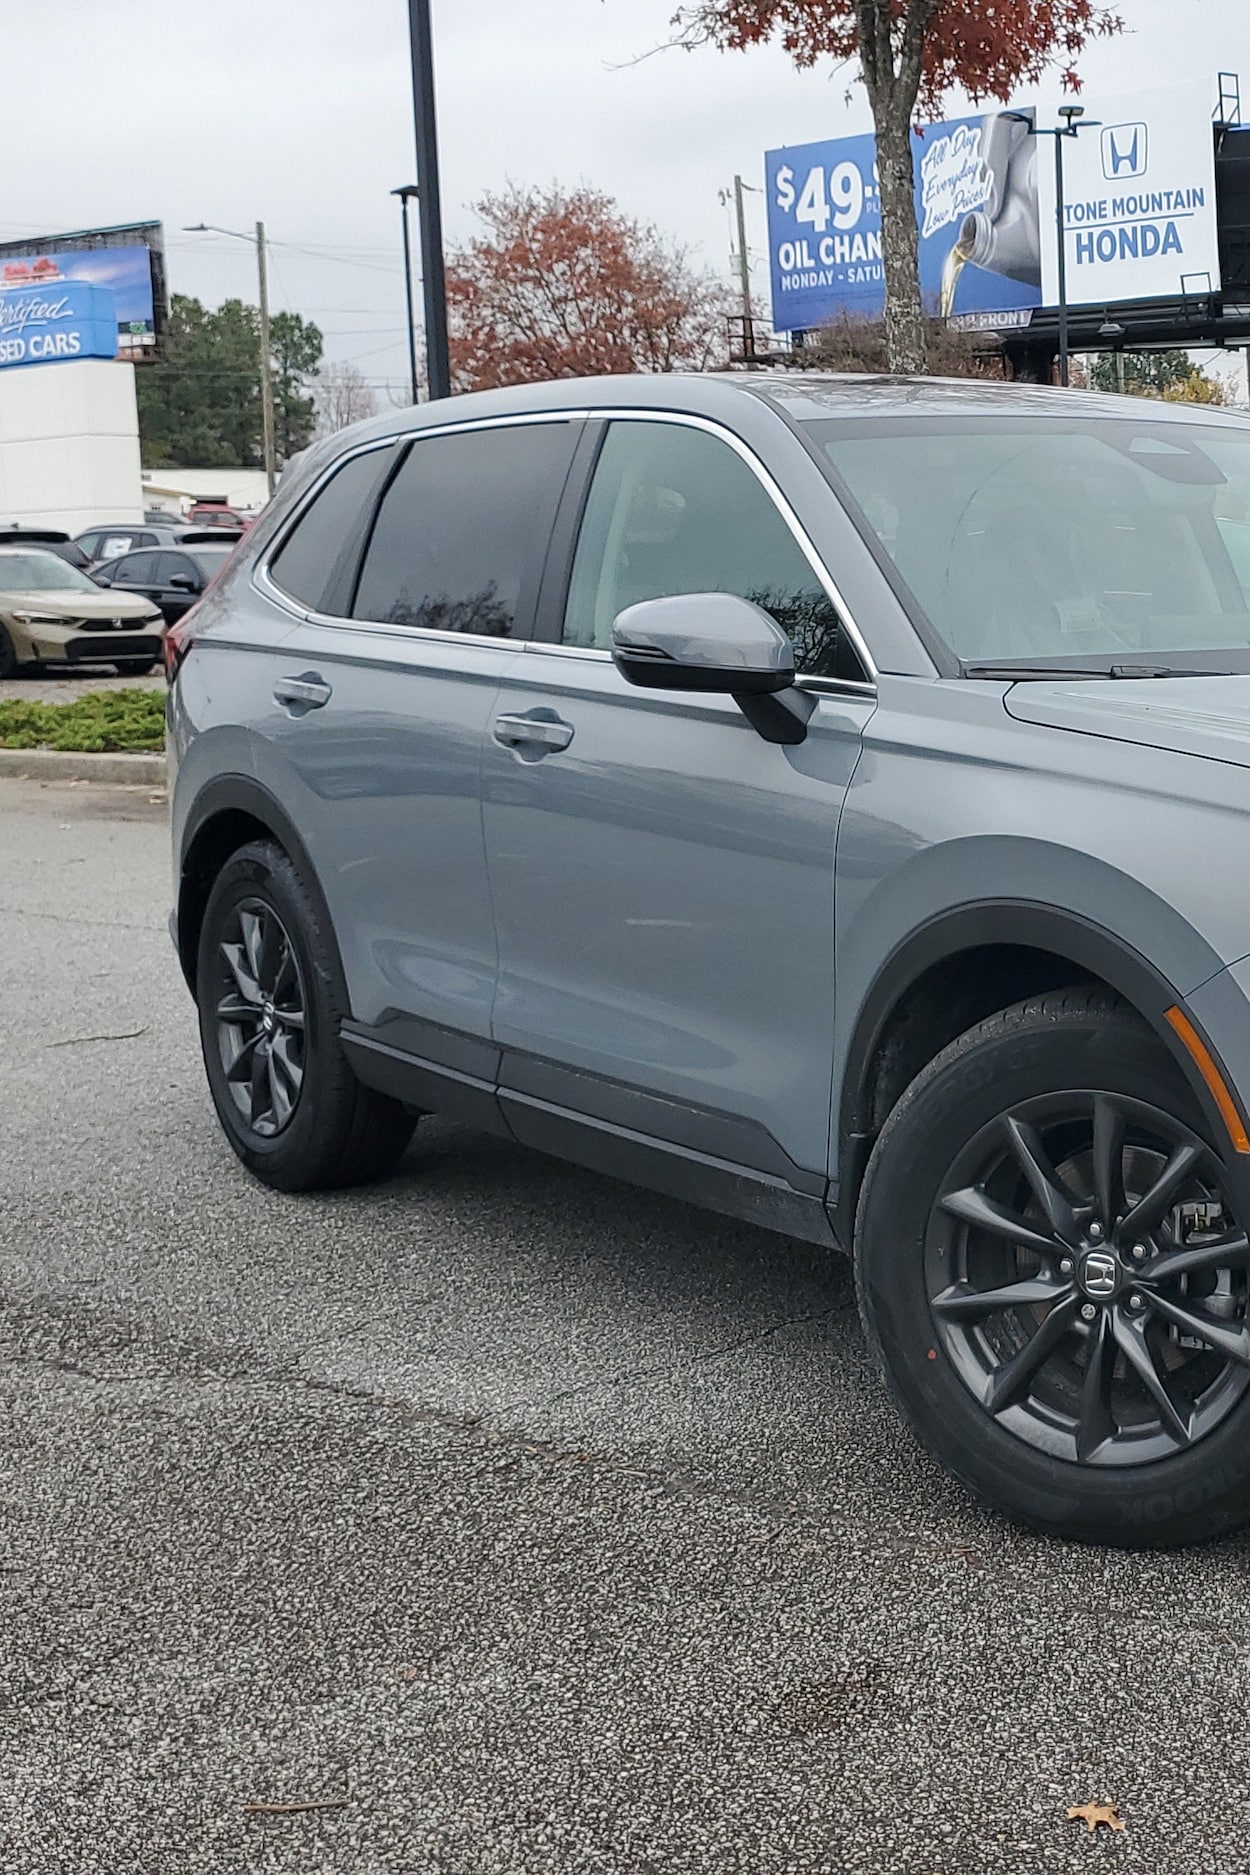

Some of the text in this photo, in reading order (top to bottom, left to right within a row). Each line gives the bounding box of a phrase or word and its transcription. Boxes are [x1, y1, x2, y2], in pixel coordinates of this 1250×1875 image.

[923, 129, 979, 175] All Day
[776, 161, 880, 232] $49.
[924, 158, 980, 203] Everyday
[1112, 187, 1205, 218] MOUNTAIN
[779, 239, 815, 271] OIL
[1075, 221, 1183, 265] HONDA
[781, 270, 834, 291] MONDAY
[847, 264, 885, 284] SATU
[0, 296, 74, 333] ertified
[29, 331, 81, 358] CARS
